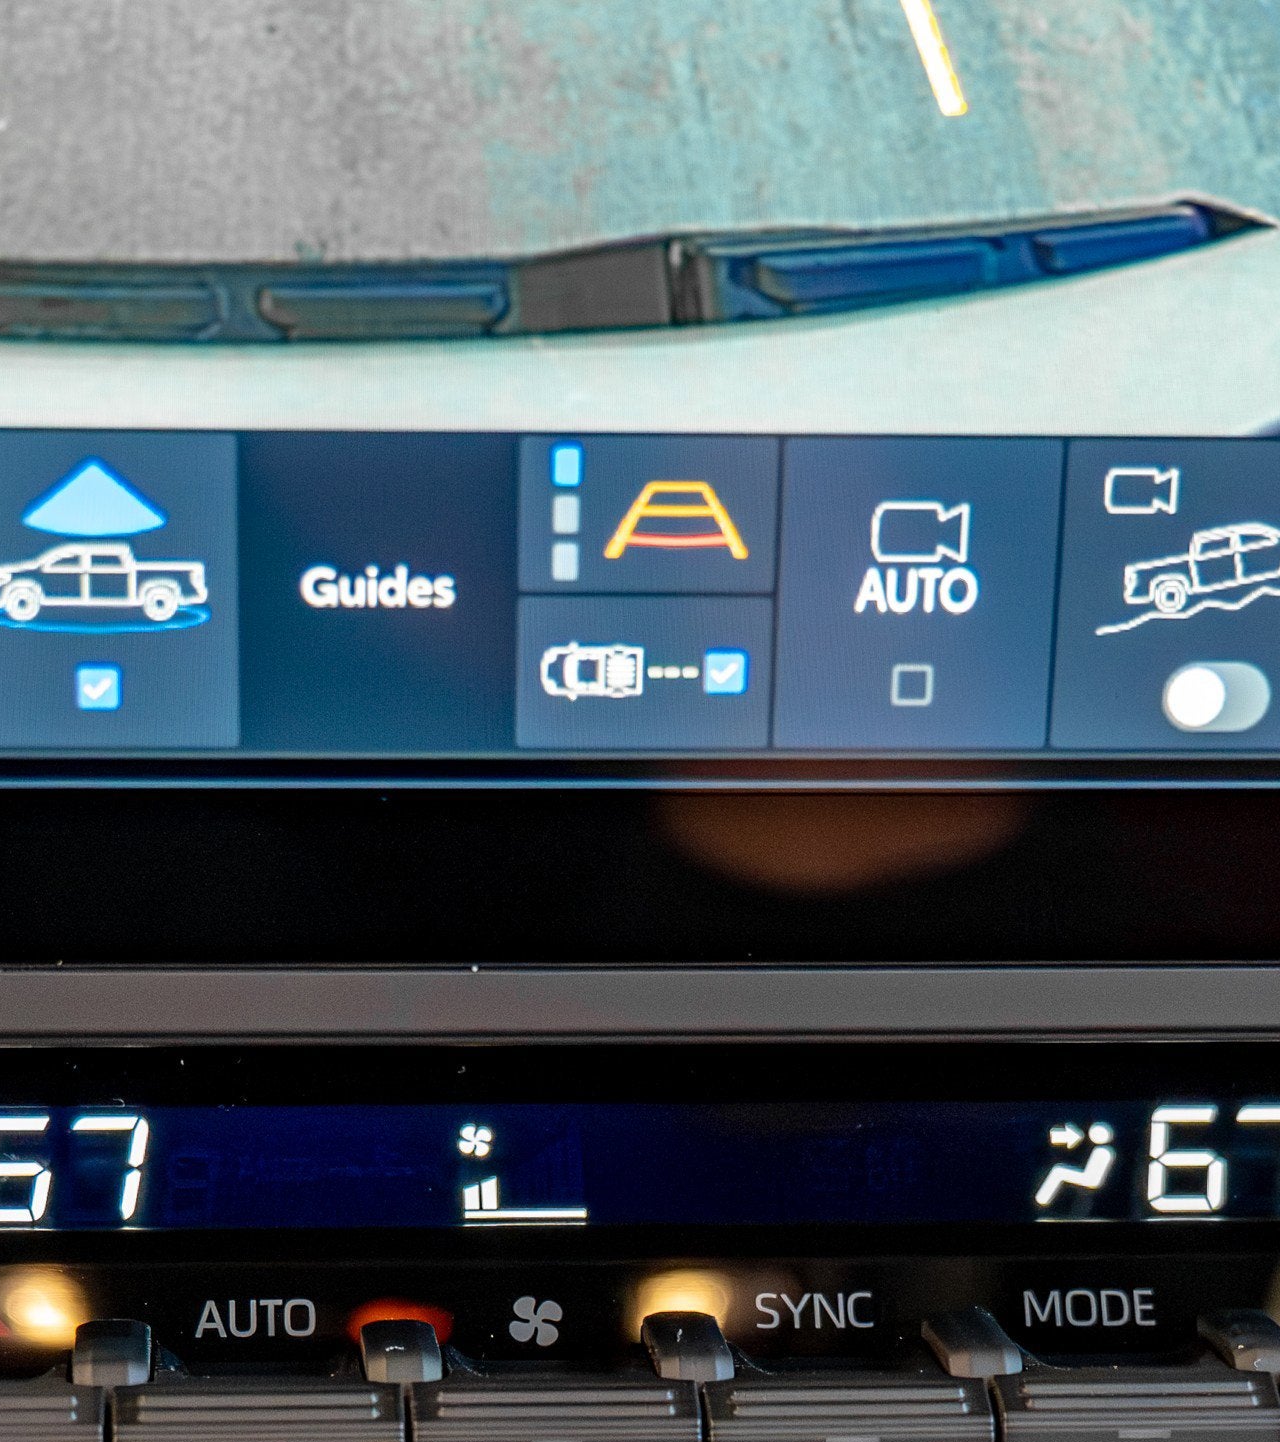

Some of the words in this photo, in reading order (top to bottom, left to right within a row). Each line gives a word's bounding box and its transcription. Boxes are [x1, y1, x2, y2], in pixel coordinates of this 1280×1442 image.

[299, 565, 456, 609] Guides
[854, 566, 978, 614] AUTO
[195, 1299, 317, 1338] AUTO
[755, 1291, 875, 1329] SYNC
[1023, 1288, 1157, 1327] MODE
